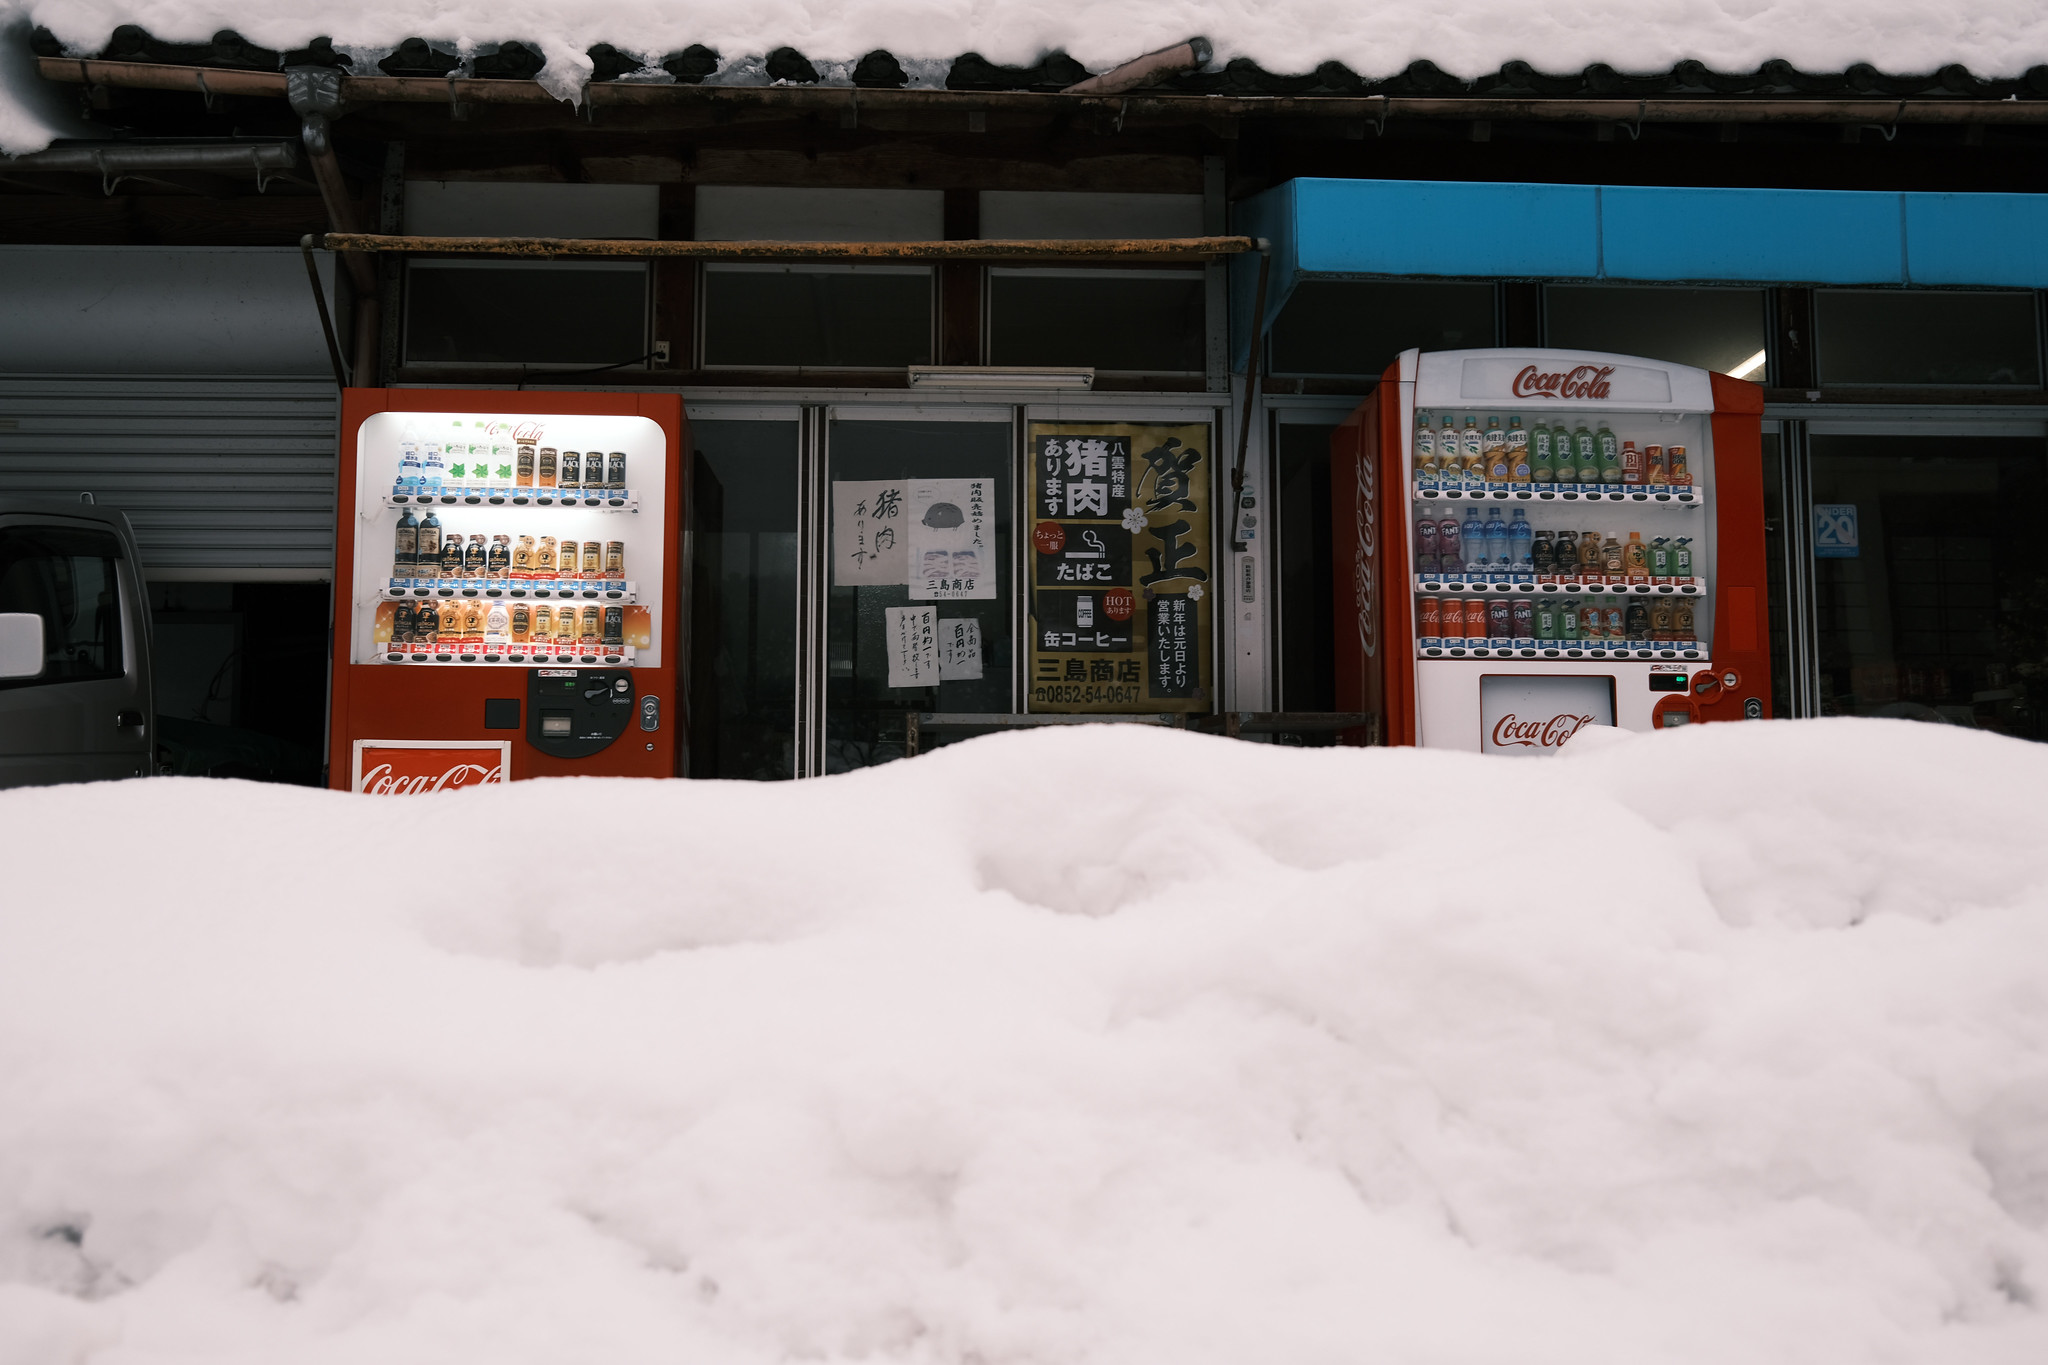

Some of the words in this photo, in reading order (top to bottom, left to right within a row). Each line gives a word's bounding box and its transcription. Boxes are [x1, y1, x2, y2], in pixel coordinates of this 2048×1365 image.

[1512, 365, 1616, 399] Coca-Cola
[1044, 438, 1063, 516] あります
[1065, 439, 1109, 516] 猪肉
[1111, 442, 1126, 498] 八雲特産
[872, 489, 902, 553] 猪肉
[970, 483, 984, 548] 猪肉販売始めました。
[1136, 437, 1208, 588] 賀正
[851, 500, 871, 570] あります
[1035, 530, 1063, 540] ちょっと
[1040, 541, 1058, 550] 一服
[1818, 516, 1855, 544] 20
[1356, 451, 1376, 657] Coca-Cola
[926, 578, 975, 591] 三島商店
[1056, 563, 1113, 581] たばこ
[1105, 596, 1132, 606] HOT
[1106, 607, 1131, 615] あります
[1044, 630, 1127, 647] 缶コーヒー
[1157, 599, 1172, 694] 営業いたします。
[1172, 599, 1187, 689] 新年は元日より
[1036, 658, 1141, 683] 三島商店
[1047, 685, 1141, 704] 0852-54-0647
[1492, 713, 1596, 747] Coca-Col
